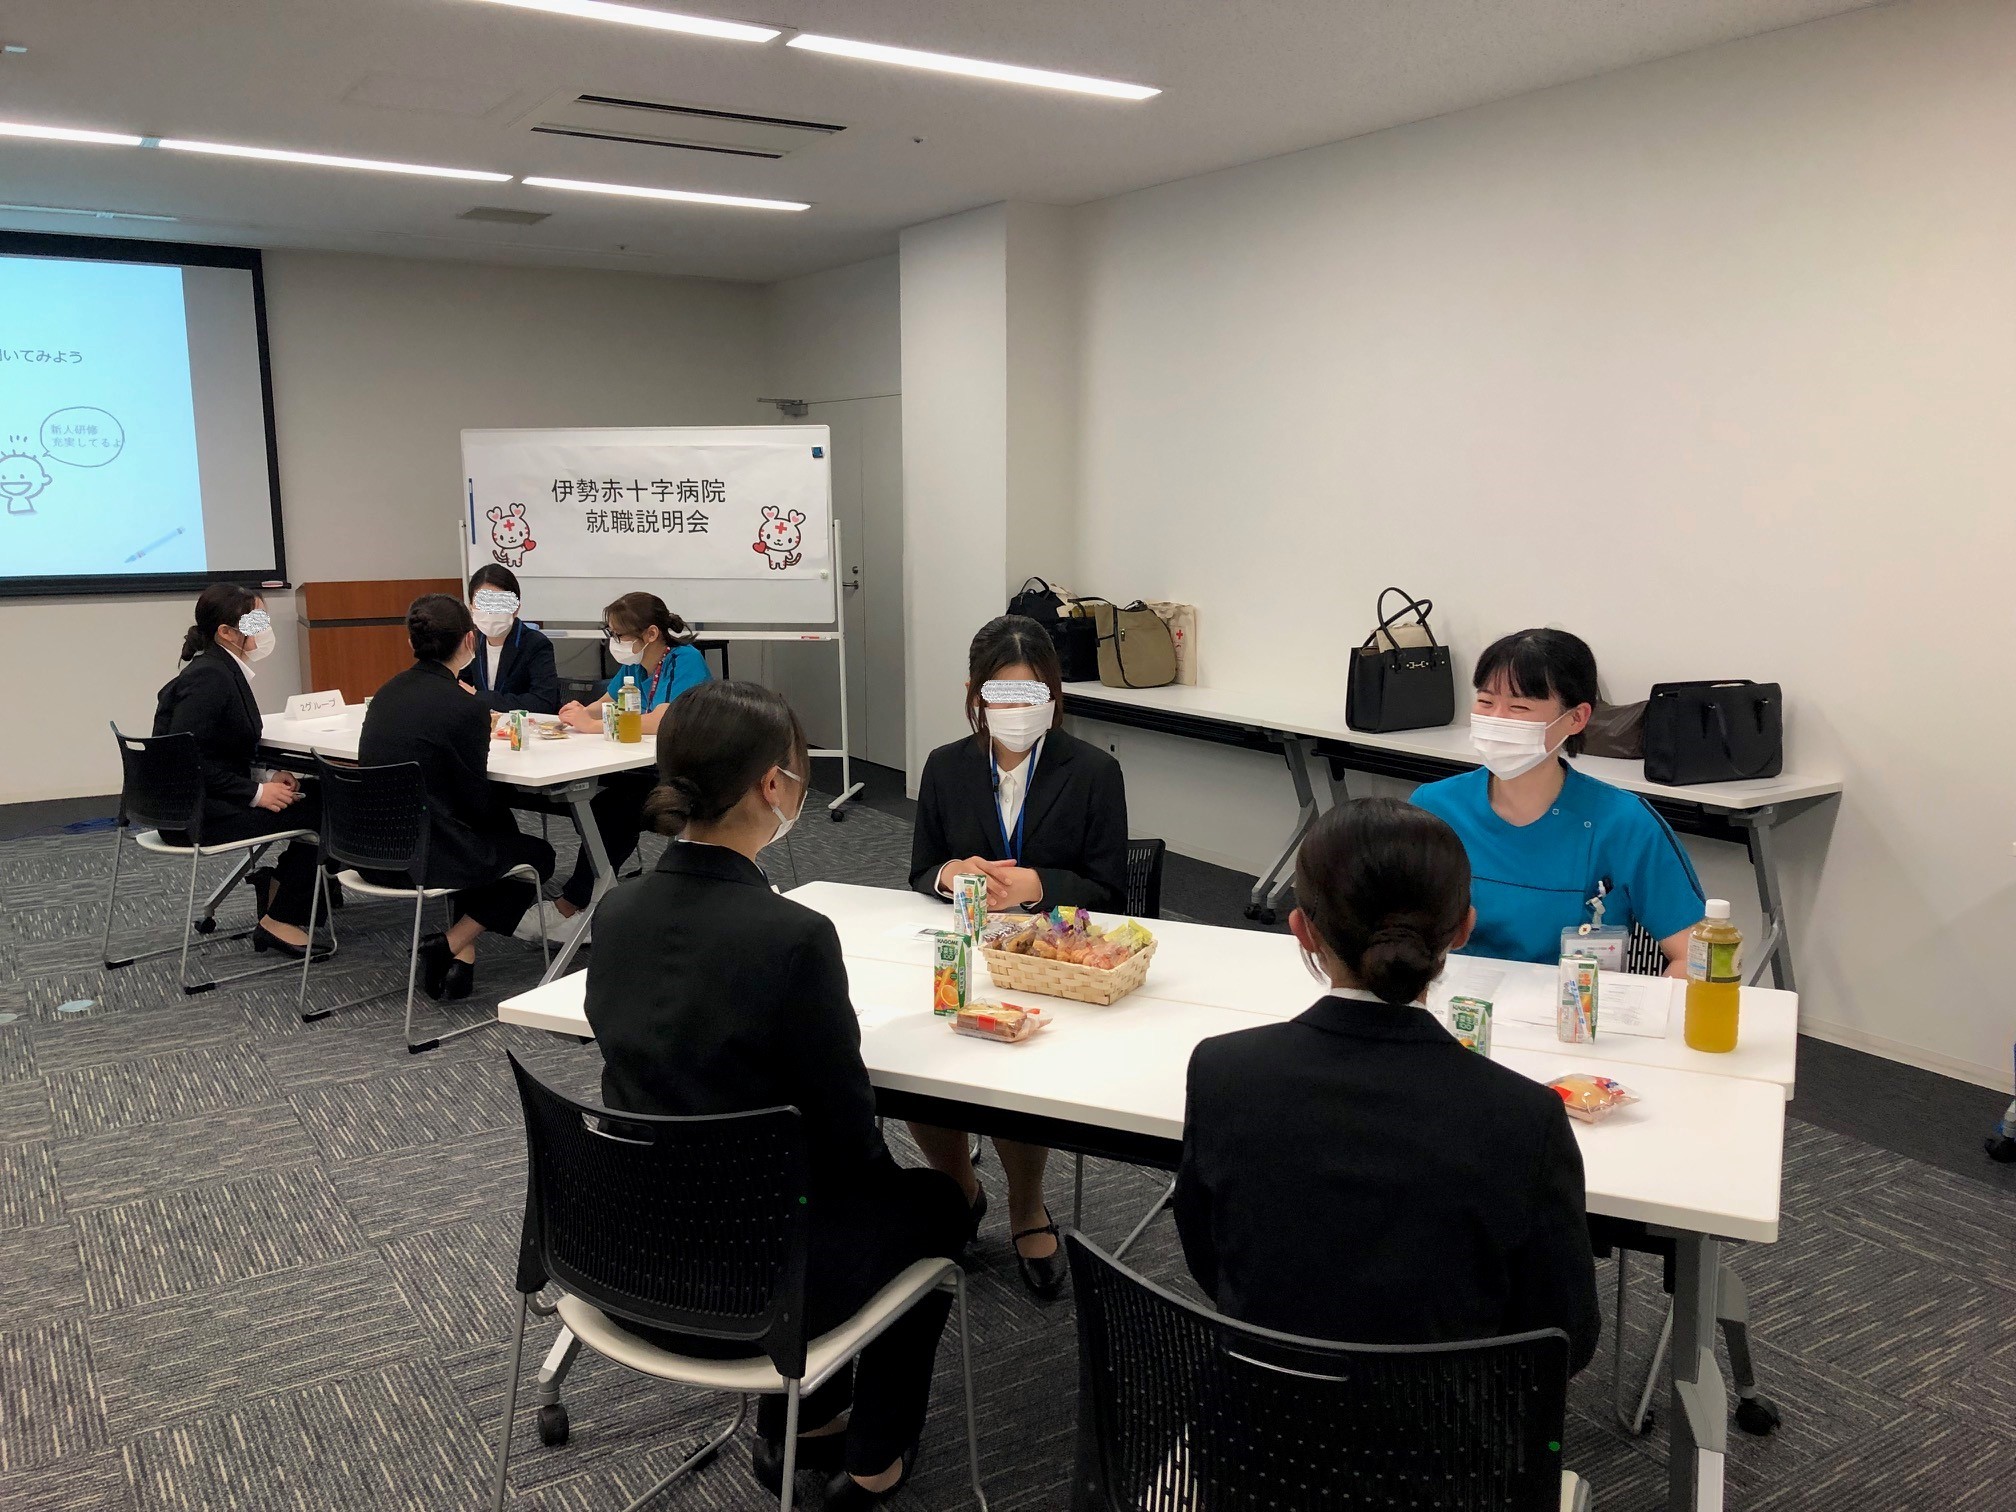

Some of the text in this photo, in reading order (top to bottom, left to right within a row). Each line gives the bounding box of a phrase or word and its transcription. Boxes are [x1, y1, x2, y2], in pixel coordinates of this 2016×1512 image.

[0, 349, 83, 363] いてみよう
[51, 424, 98, 435] 新人研修
[551, 478, 726, 503] 伊勢赤十字病院
[586, 509, 710, 534] 就職説明会
[937, 938, 959, 946] KAGOME
[1453, 1004, 1480, 1014] KAGOME
